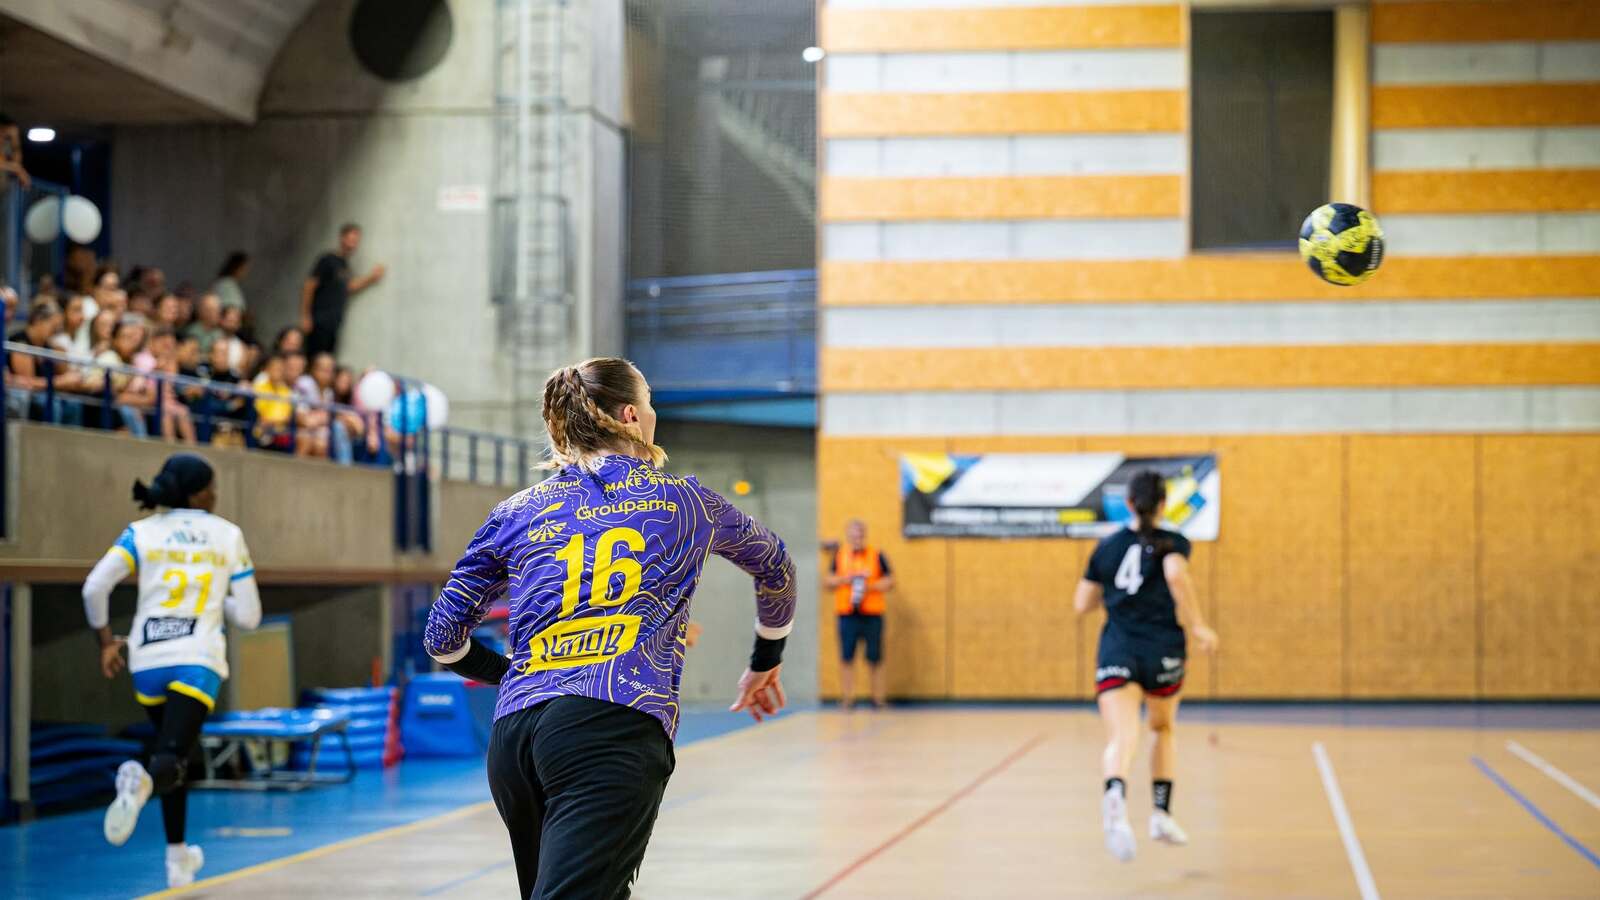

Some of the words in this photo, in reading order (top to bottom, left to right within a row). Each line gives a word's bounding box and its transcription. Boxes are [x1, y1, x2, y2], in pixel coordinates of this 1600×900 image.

[604, 477, 643, 492] MAKE
[575, 499, 677, 521] Groupama
[555, 527, 646, 619] 16
[1114, 543, 1144, 595] 4
